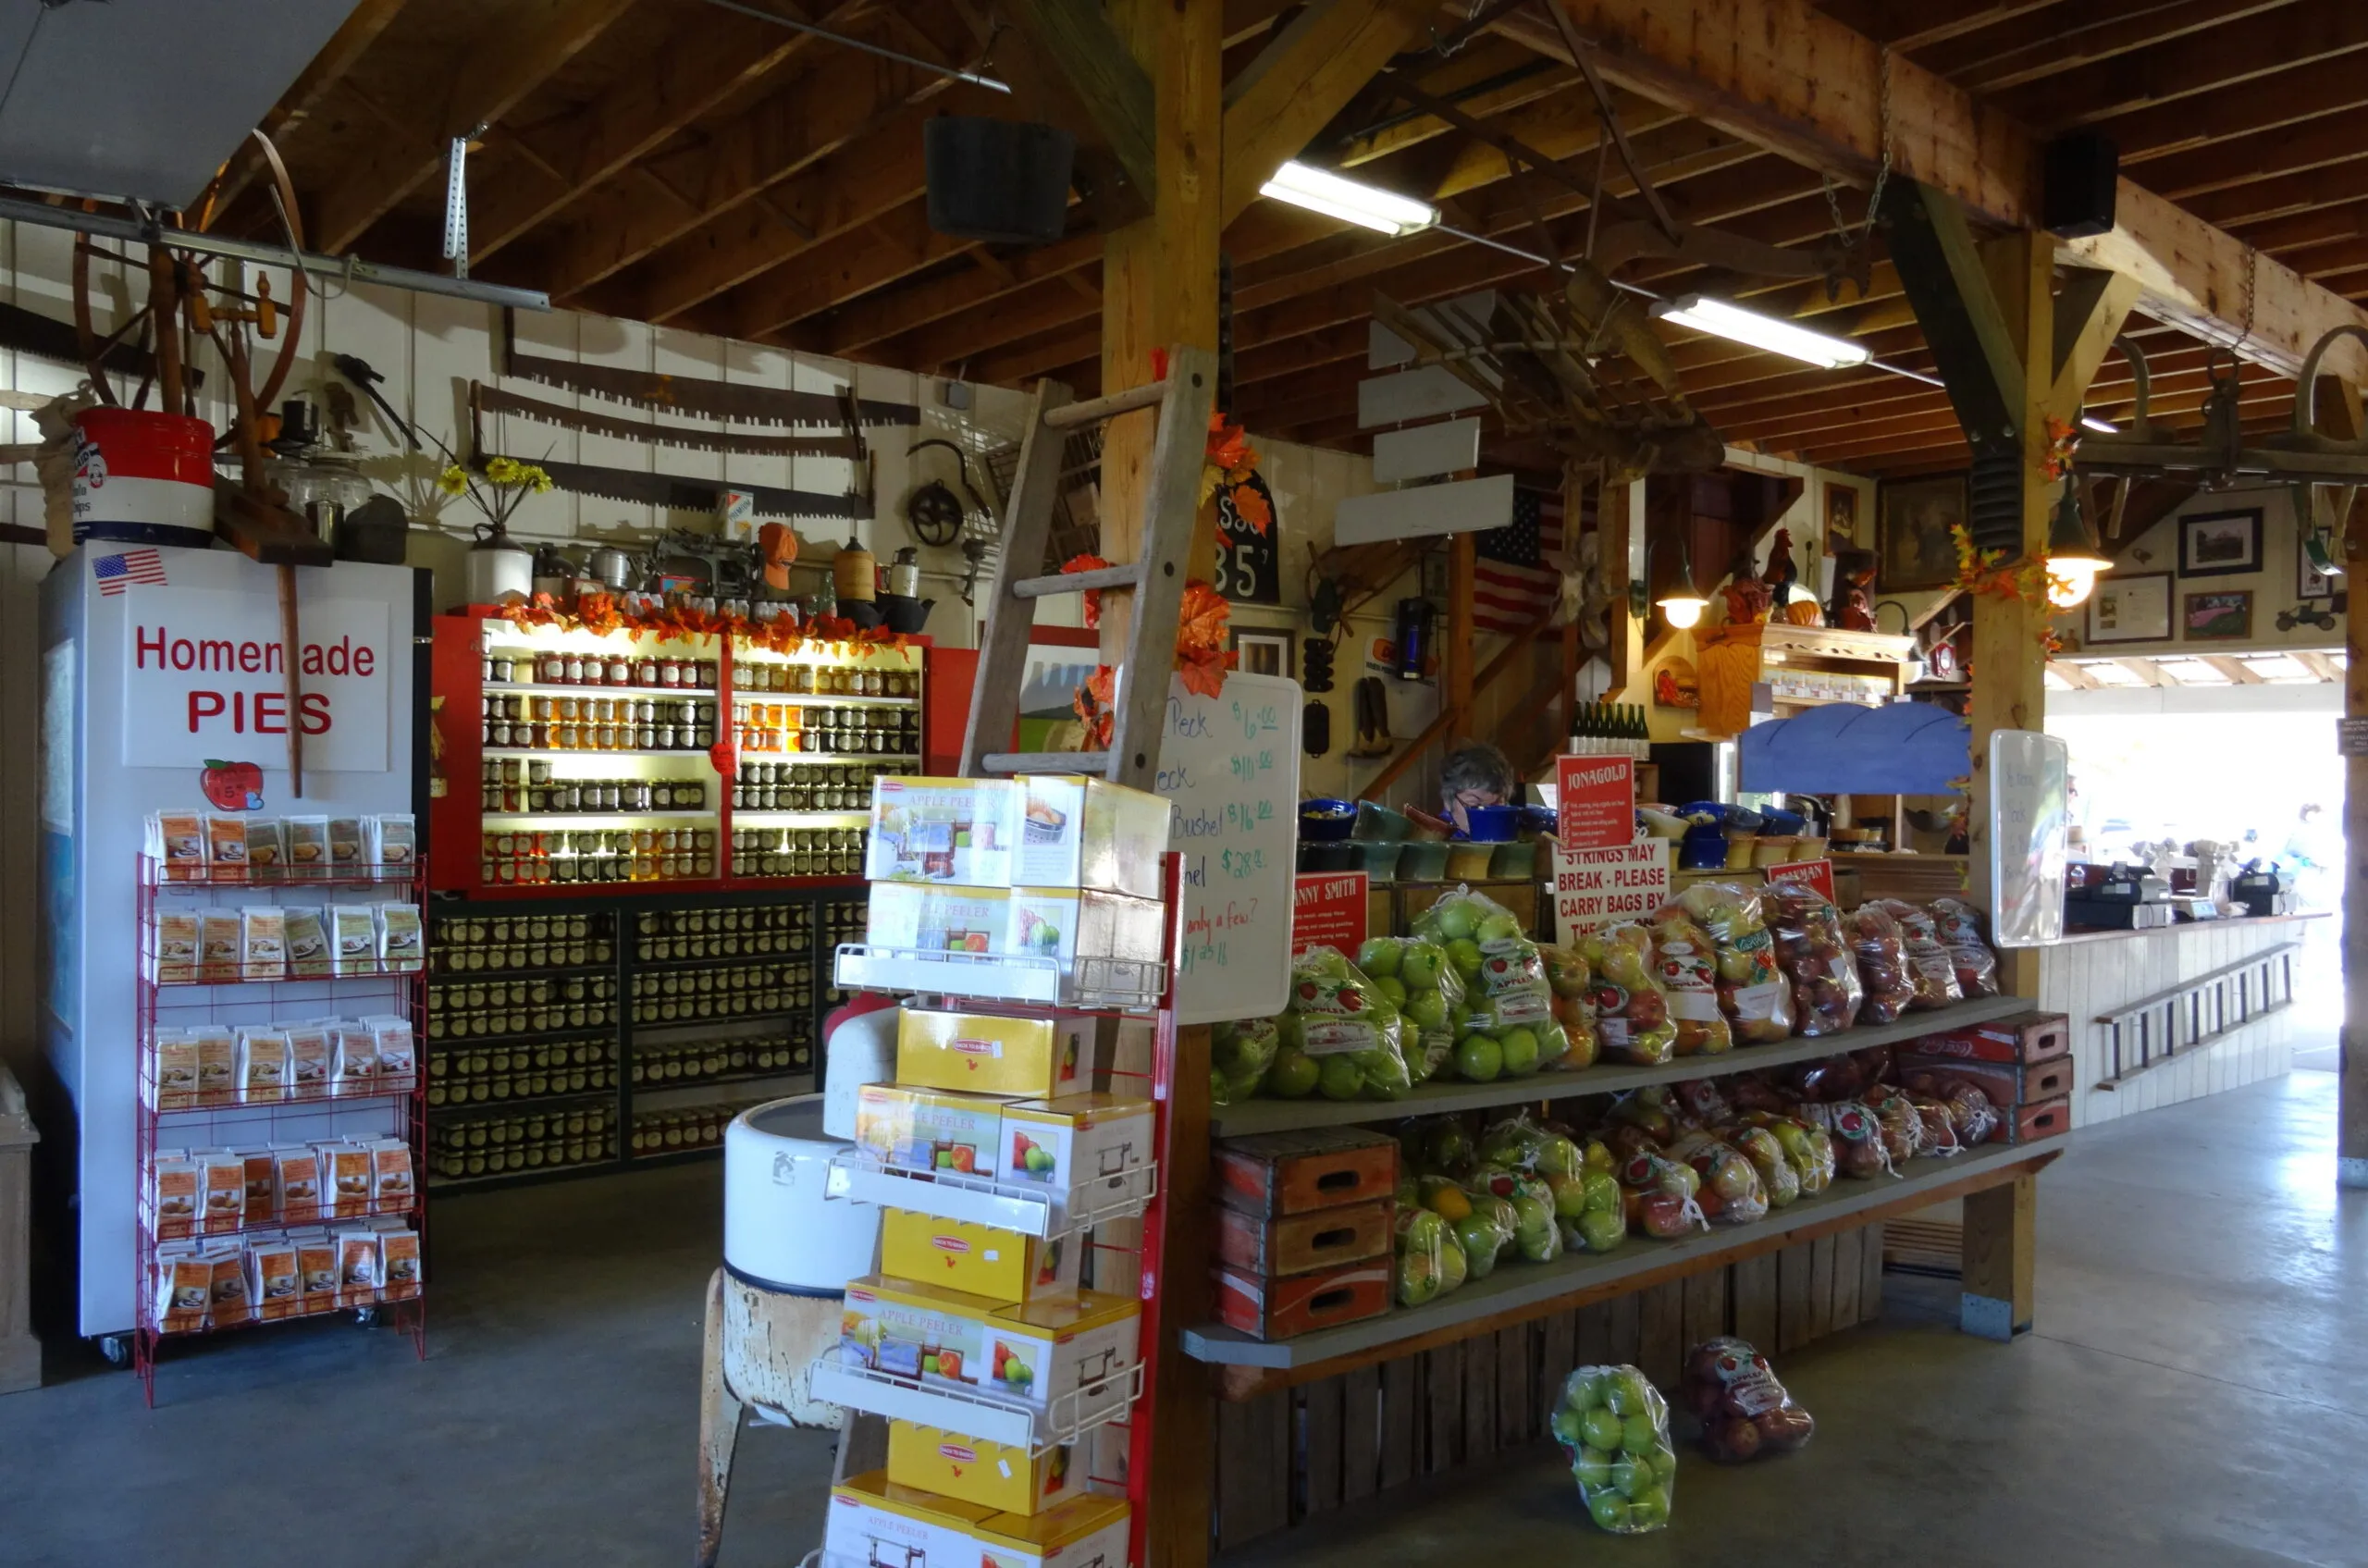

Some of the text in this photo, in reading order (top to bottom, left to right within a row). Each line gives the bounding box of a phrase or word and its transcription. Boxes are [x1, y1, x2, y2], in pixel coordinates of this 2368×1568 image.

[729, 498, 752, 523] PREMIUM
[137, 626, 375, 677] Homemade
[188, 691, 332, 735] PIES
[1167, 696, 1213, 738] Peck
[1157, 760, 1196, 790] eck
[1567, 764, 1627, 792] JONAGOLD
[910, 795, 946, 806] APPLE
[1172, 804, 1223, 839] Bushel
[1566, 844, 1656, 866] STRINGS MAY
[1295, 878, 1356, 907] ANNY SMITH
[1559, 871, 1602, 892] BREAK
[1615, 868, 1665, 888] PLEASE
[945, 903, 990, 920] PEELER
[1560, 892, 1665, 918] CARRY BAGS BY
[1187, 898, 1258, 945] only a few?
[931, 1113, 975, 1130] PEELER
[882, 1309, 963, 1337] APPLE PEELER
[868, 1516, 929, 1540] APPLE PEELER
